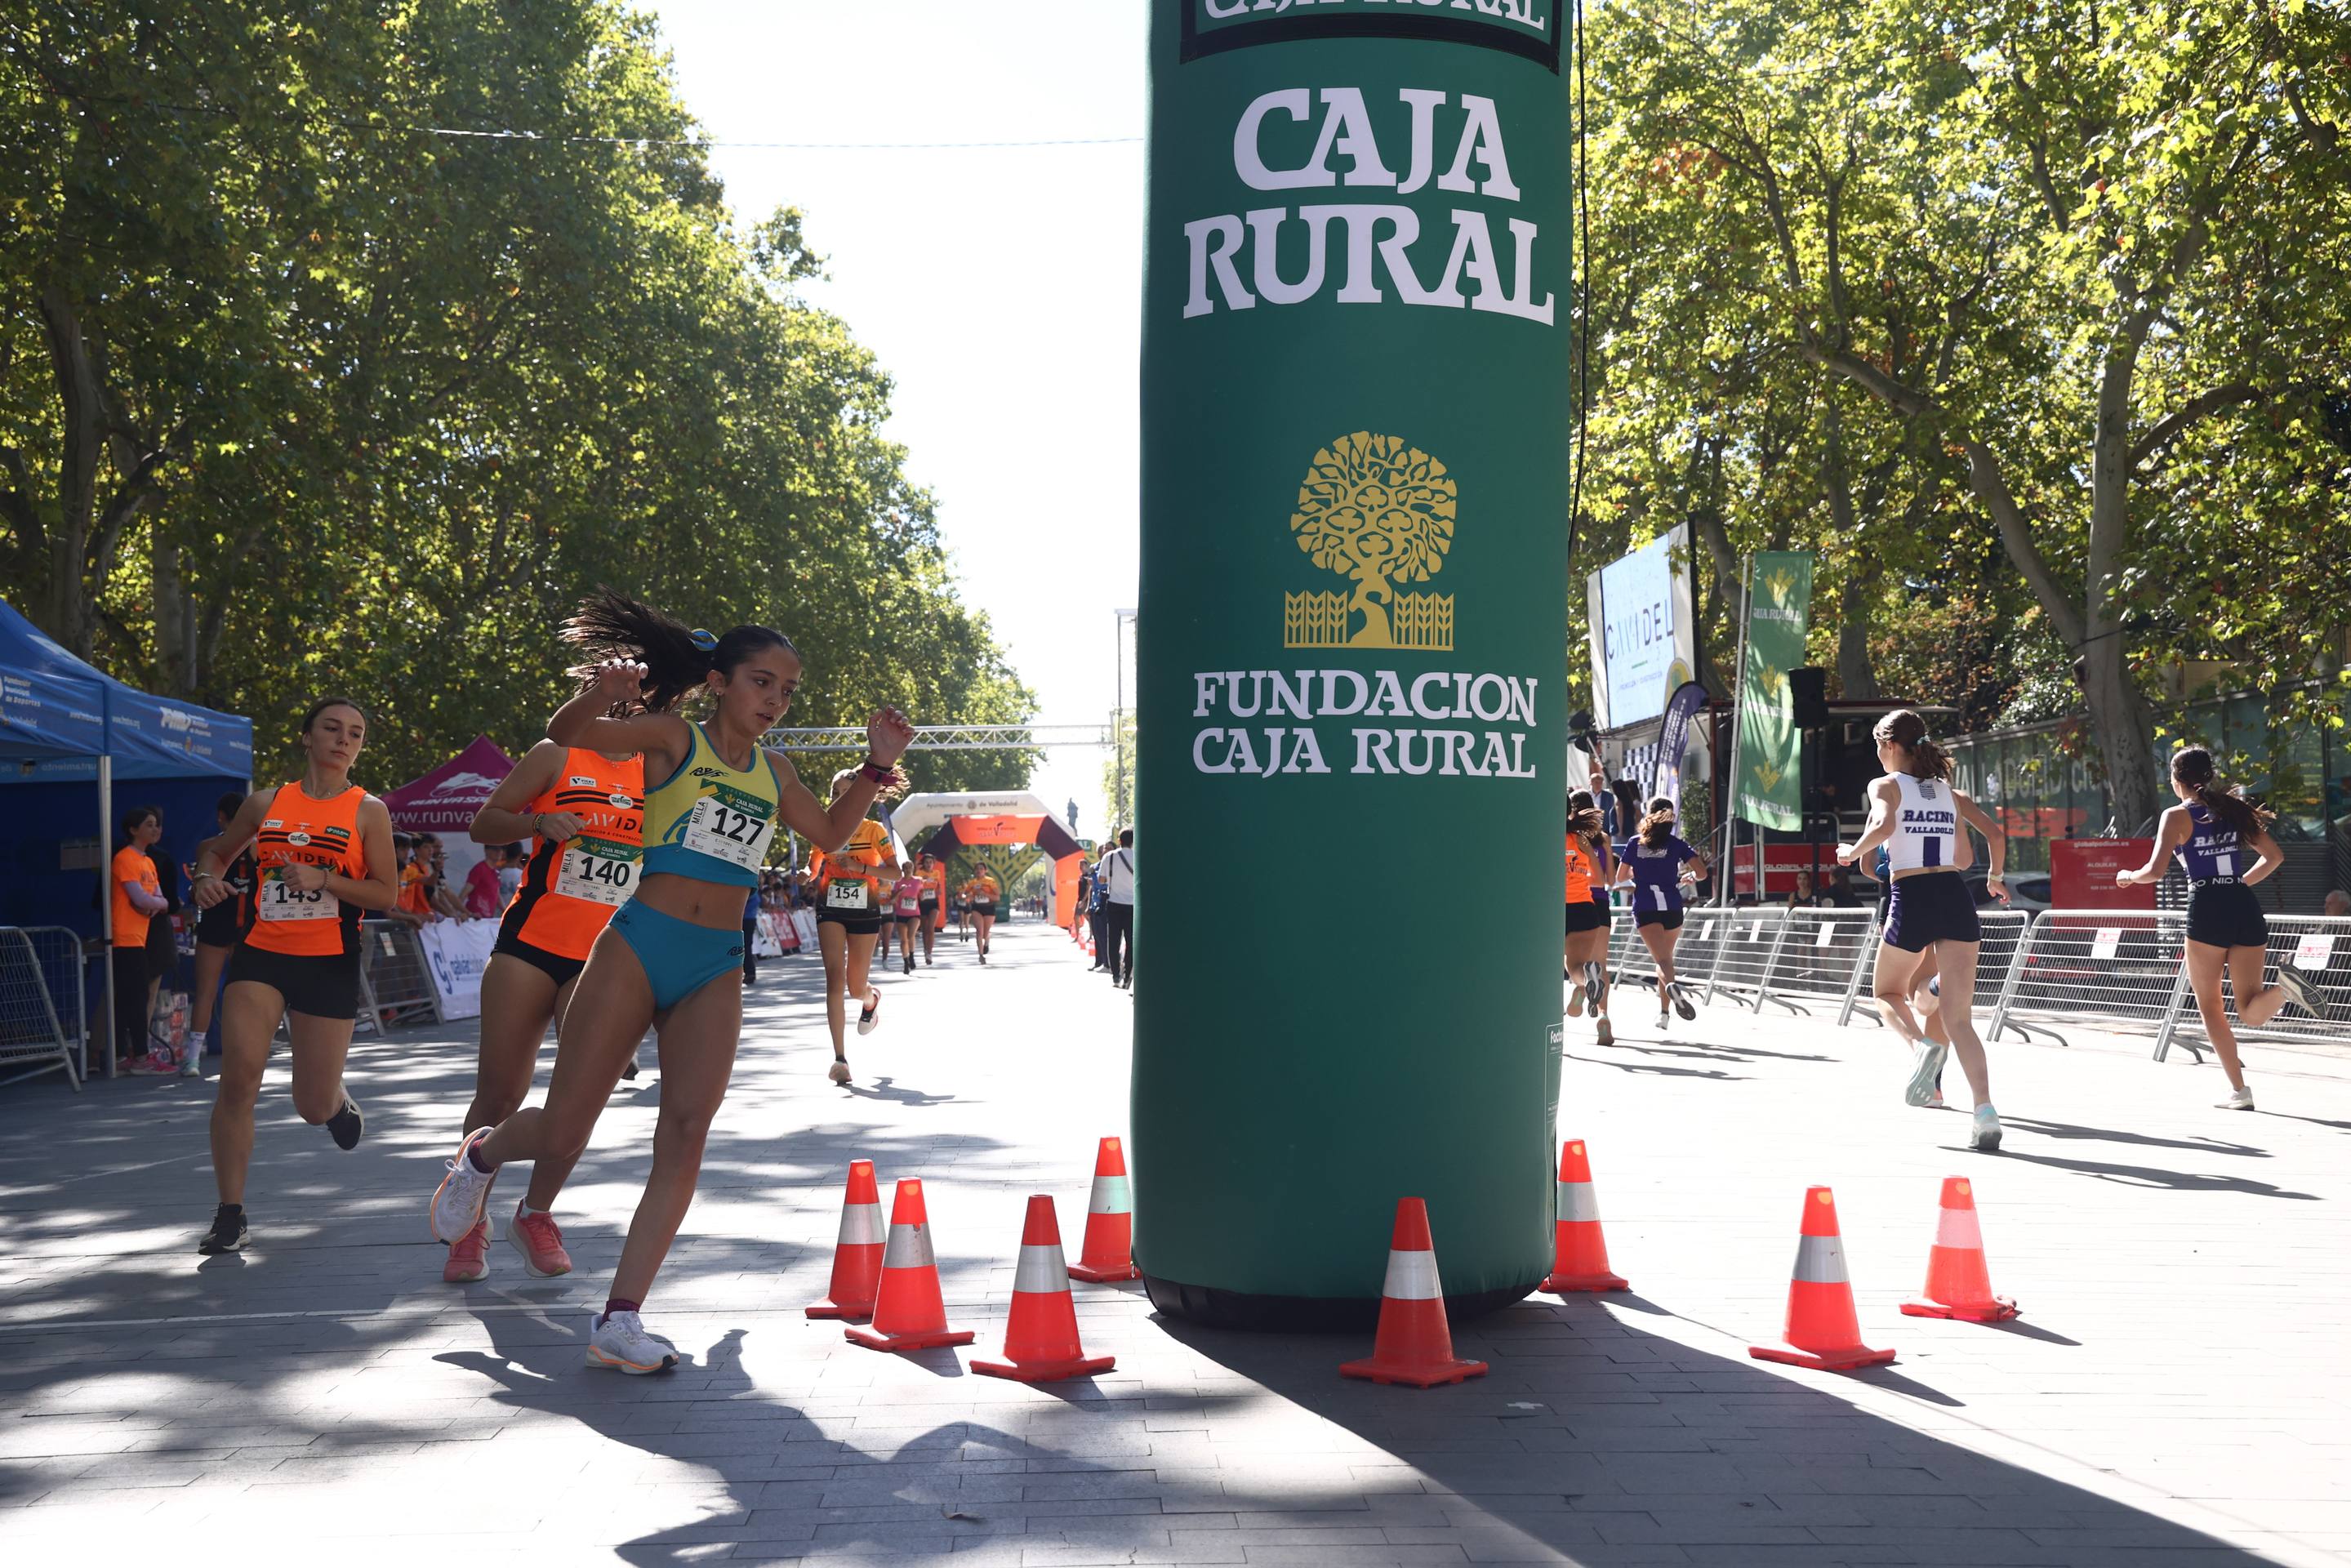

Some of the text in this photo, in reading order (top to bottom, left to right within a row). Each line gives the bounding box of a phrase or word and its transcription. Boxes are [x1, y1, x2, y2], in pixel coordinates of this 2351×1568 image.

[1234, 87, 1520, 202] CAJA
[1183, 204, 1554, 327] RURAL
[1193, 670, 1538, 727] FUNDACION
[1193, 728, 1535, 777] CAJA RURAL
[692, 801, 706, 824] MILLA
[711, 807, 764, 846] 127
[1902, 810, 1954, 823] RACING
[561, 853, 572, 873] MILLA
[579, 857, 630, 887] 140
[275, 883, 322, 903] 143
[835, 887, 859, 899] 154
